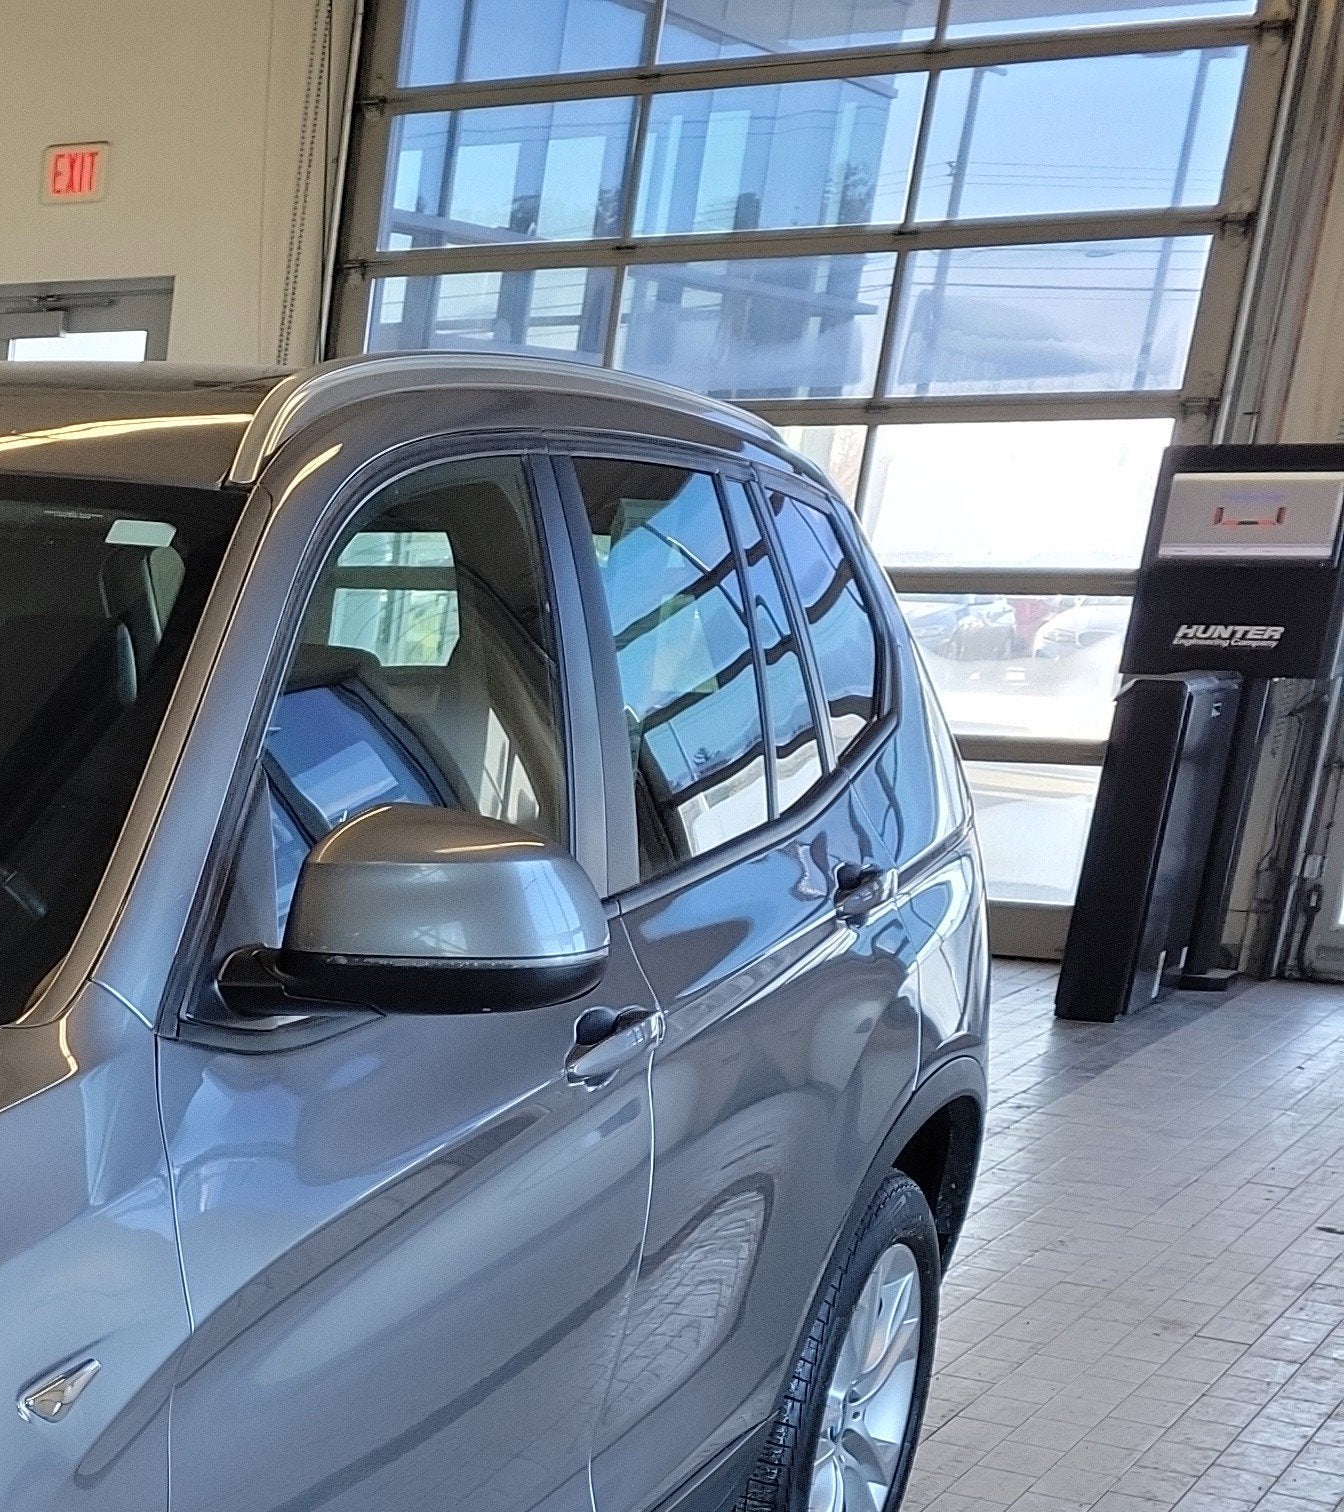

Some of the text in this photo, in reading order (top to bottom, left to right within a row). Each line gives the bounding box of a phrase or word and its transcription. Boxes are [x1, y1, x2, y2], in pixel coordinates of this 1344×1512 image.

[52, 151, 99, 194] EXIT
[1175, 624, 1285, 639] HUNTER
[1230, 637, 1280, 648] Company
